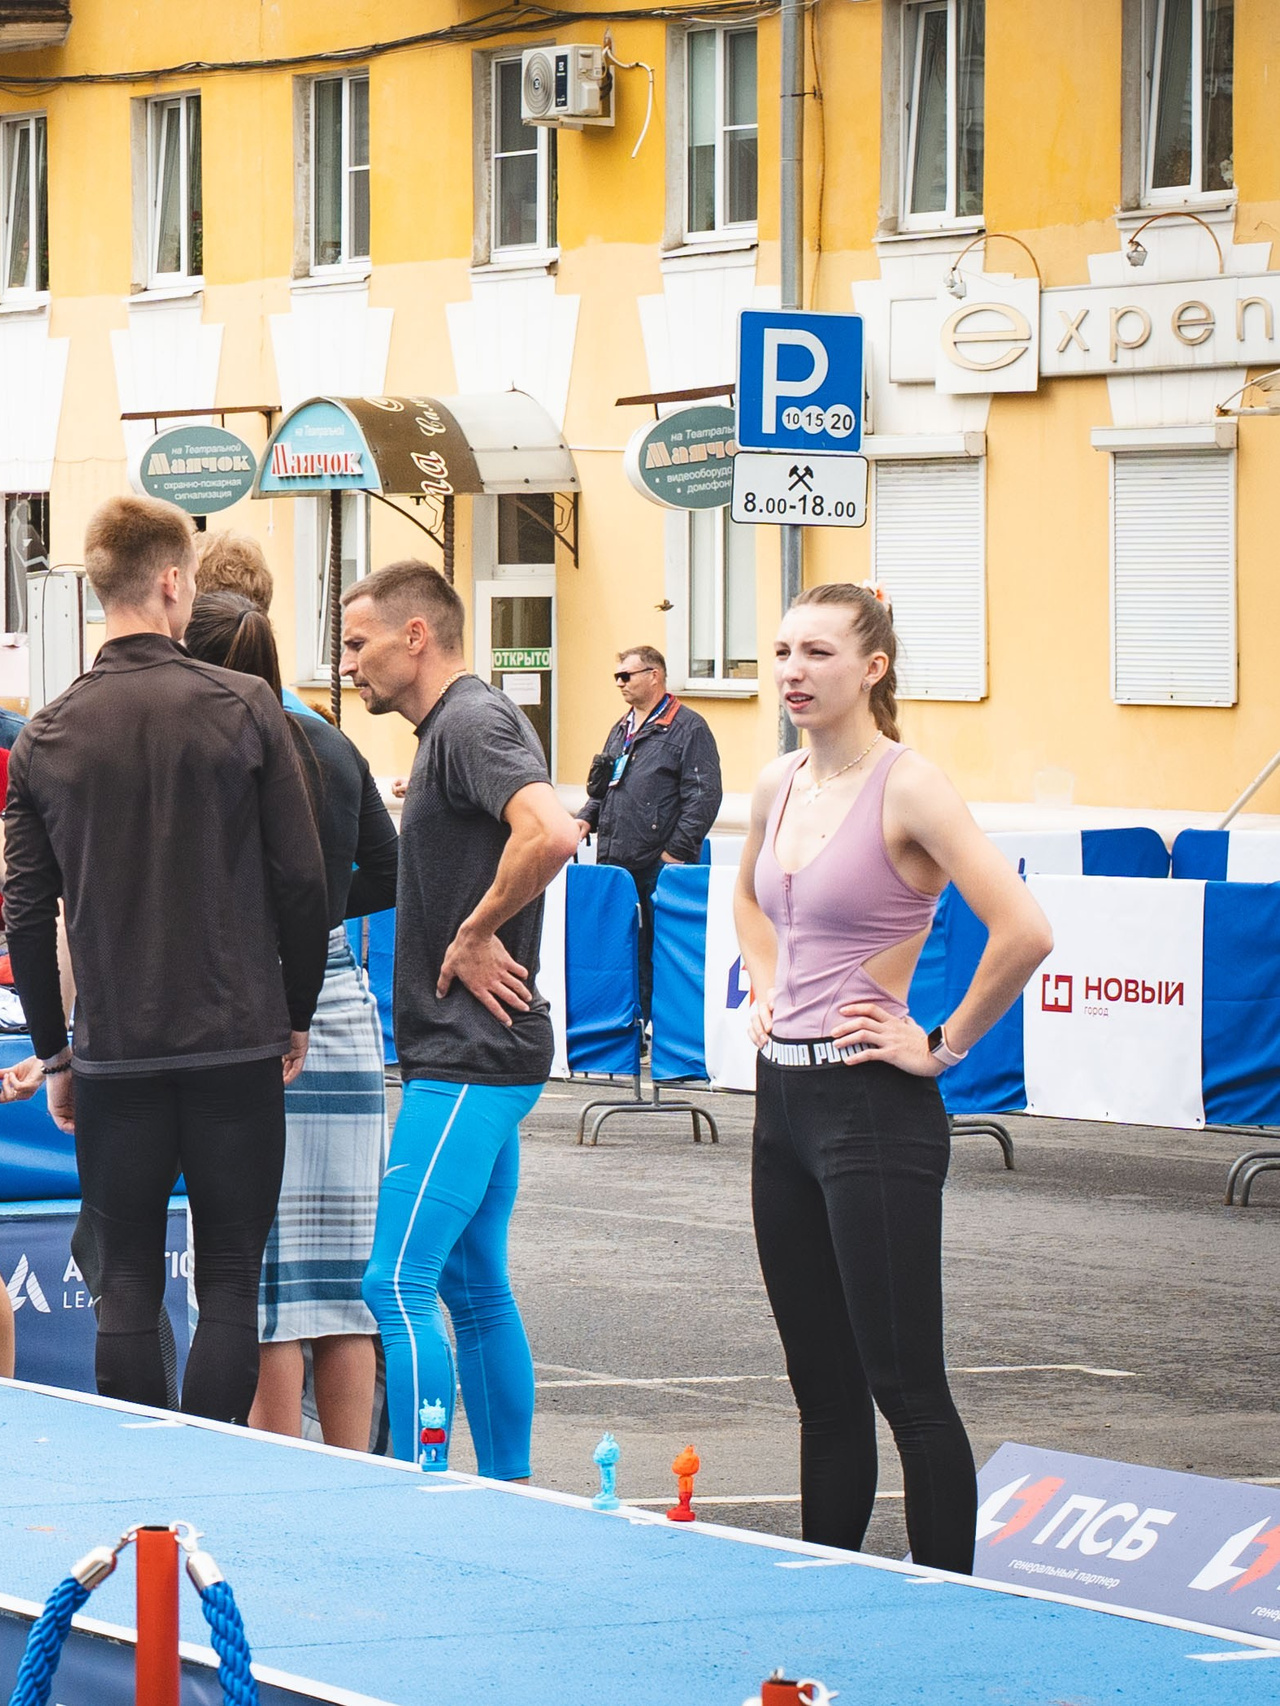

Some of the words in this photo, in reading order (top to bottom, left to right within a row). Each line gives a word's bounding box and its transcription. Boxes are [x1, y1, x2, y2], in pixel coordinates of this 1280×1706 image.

[762, 328, 829, 434] P
[785, 411, 801, 425] 10
[805, 411, 824, 427] 15
[830, 413, 853, 431] 20
[671, 432, 683, 442] на
[685, 426, 736, 439] Театраль
[171, 447, 183, 455] на
[185, 443, 242, 455] Театральной
[645, 439, 739, 469] Маячо
[148, 453, 251, 476] Маячок
[271, 443, 363, 477] Маячок
[164, 479, 242, 491] охранно-пожарная
[667, 466, 733, 484] видеооборудо
[174, 490, 232, 501] сигнализация
[687, 480, 732, 495] домофон
[744, 491, 856, 518] 8.00-18.00
[494, 652, 549, 667] ОТКРЫТО
[1085, 976, 1184, 1006] НОВЫЙ
[1084, 1006, 1109, 1017] город
[1031, 1493, 1177, 1561] ПСБ
[1008, 1559, 1079, 1579] генеральный
[1075, 1571, 1121, 1589] партнер
